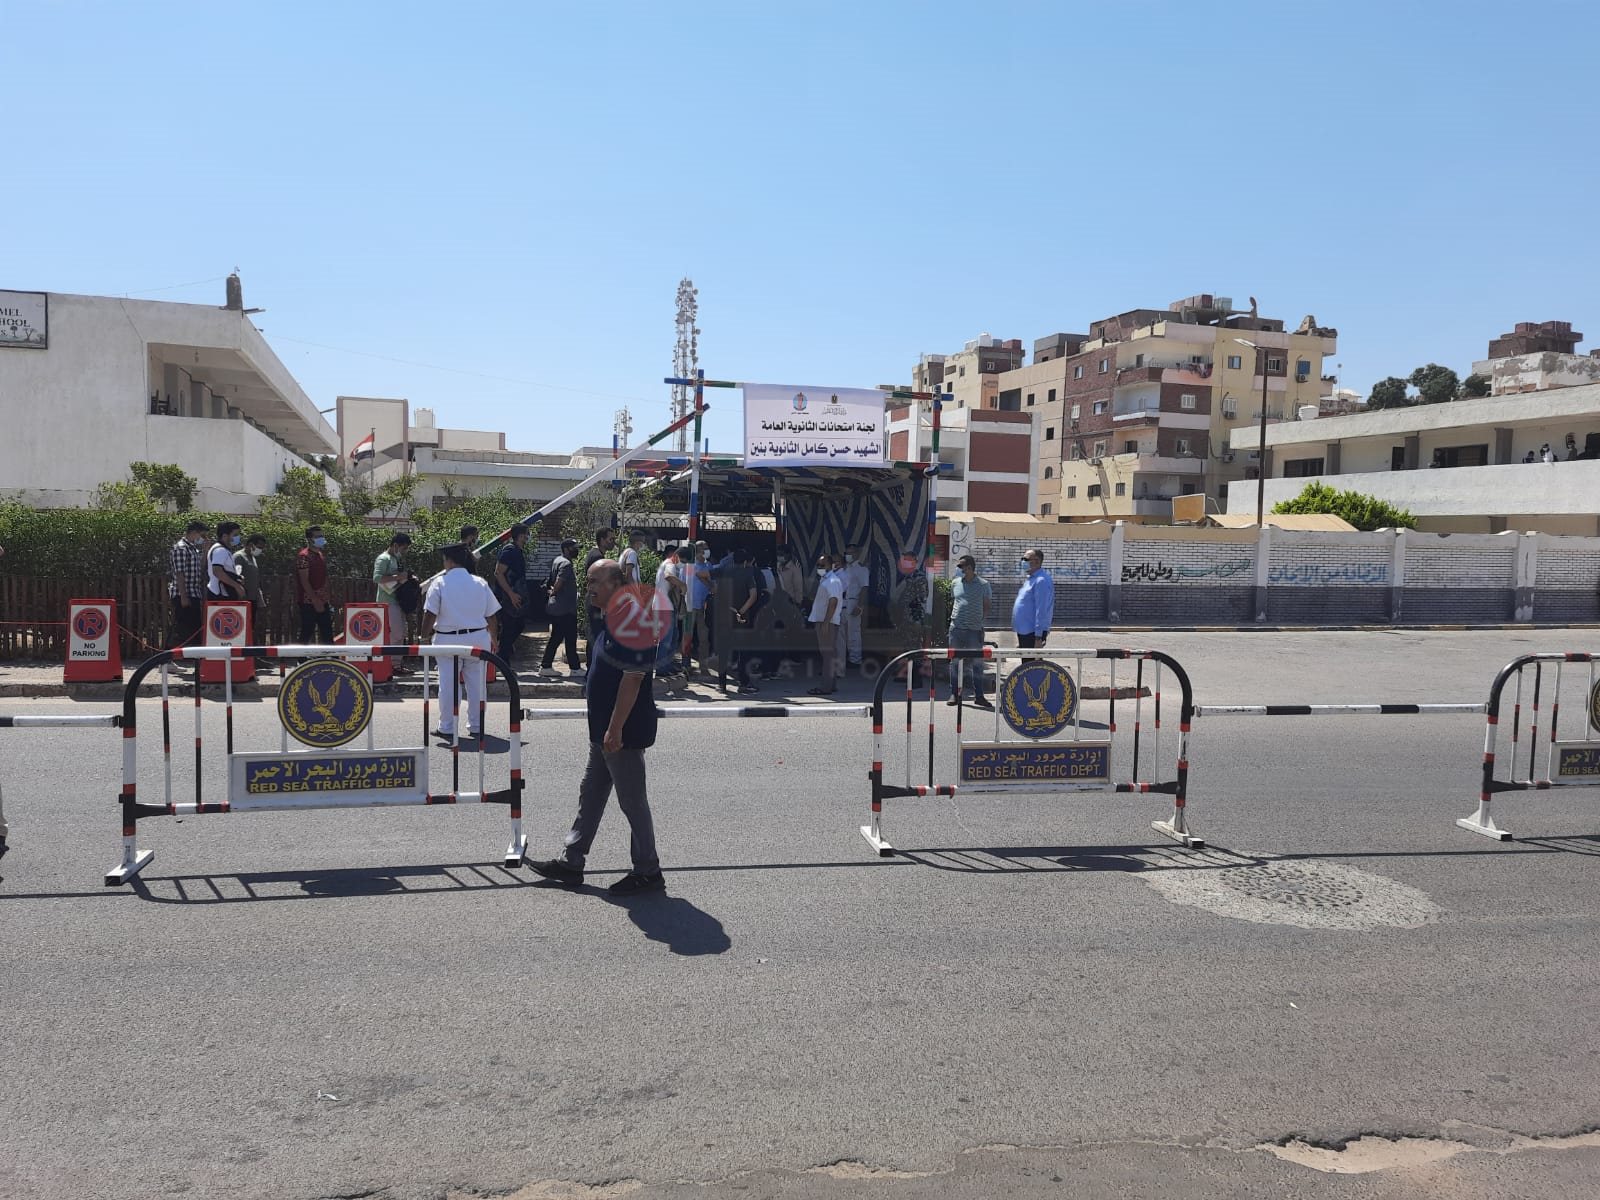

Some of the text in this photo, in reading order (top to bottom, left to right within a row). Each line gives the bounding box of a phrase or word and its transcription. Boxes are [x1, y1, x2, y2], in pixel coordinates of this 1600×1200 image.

[761, 420, 875, 435] لجنة امتحانات الثانوية العامة
[750, 441, 882, 457] الشهيد حسن كامل الثانوية بنين
[1003, 751, 1030, 764] البحر
[1034, 753, 1066, 763] مرور
[303, 760, 343, 781] البحر
[345, 763, 377, 780] مرور
[967, 764, 1102, 778] RED SEA TRAFFIC DEPT.
[1561, 766, 1599, 775] RED SEA
[250, 777, 413, 793] RED SEA TRAFFIC DEPT.
